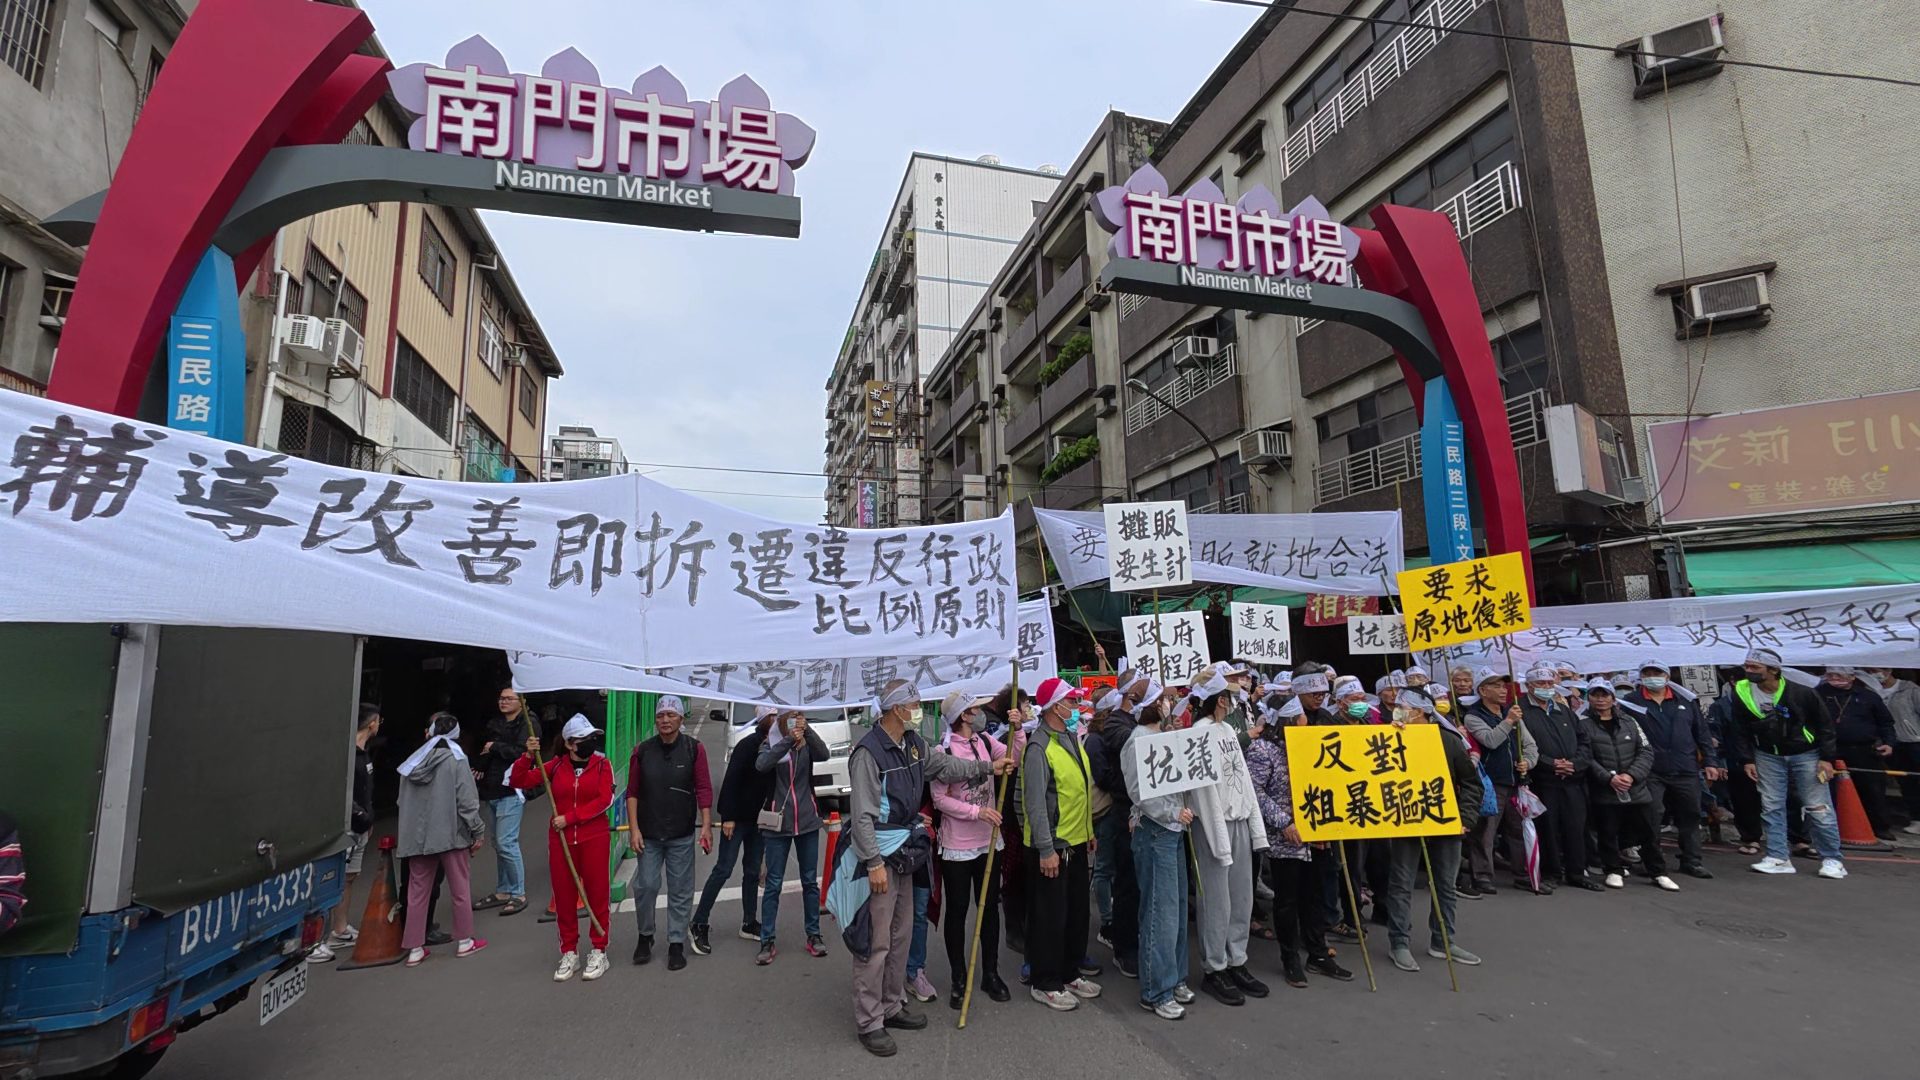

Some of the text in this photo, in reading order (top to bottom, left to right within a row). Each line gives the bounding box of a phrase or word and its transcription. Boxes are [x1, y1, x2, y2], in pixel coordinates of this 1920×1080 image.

[424, 64, 782, 192] 南門市場
[496, 160, 712, 208] Nanmen Market
[1124, 191, 1348, 285] 南門市場
[1181, 265, 1313, 300] Nanmen Market
[1684, 425, 1790, 474] 艾莉
[862, 483, 875, 528] 大富翁
[1117, 507, 1184, 541] 攤販
[1069, 526, 1389, 580] 要販就地合法
[1114, 545, 1188, 583] 要生計
[1423, 563, 1497, 604] 要求
[812, 586, 1006, 640] 比例原則
[1136, 617, 1196, 648] 政府
[1239, 606, 1280, 631] 違反
[1354, 621, 1409, 650] 抗議
[1411, 591, 1525, 643] 原地復業
[1135, 650, 1207, 680] 要程序
[1236, 638, 1290, 661] 比例原則
[1143, 736, 1220, 790] 抗議
[1313, 731, 1408, 776] 反對
[1299, 775, 1457, 832] 粗暴驅趕
[180, 861, 314, 956] BUV-5333
[261, 968, 307, 1018] BUV-5333
